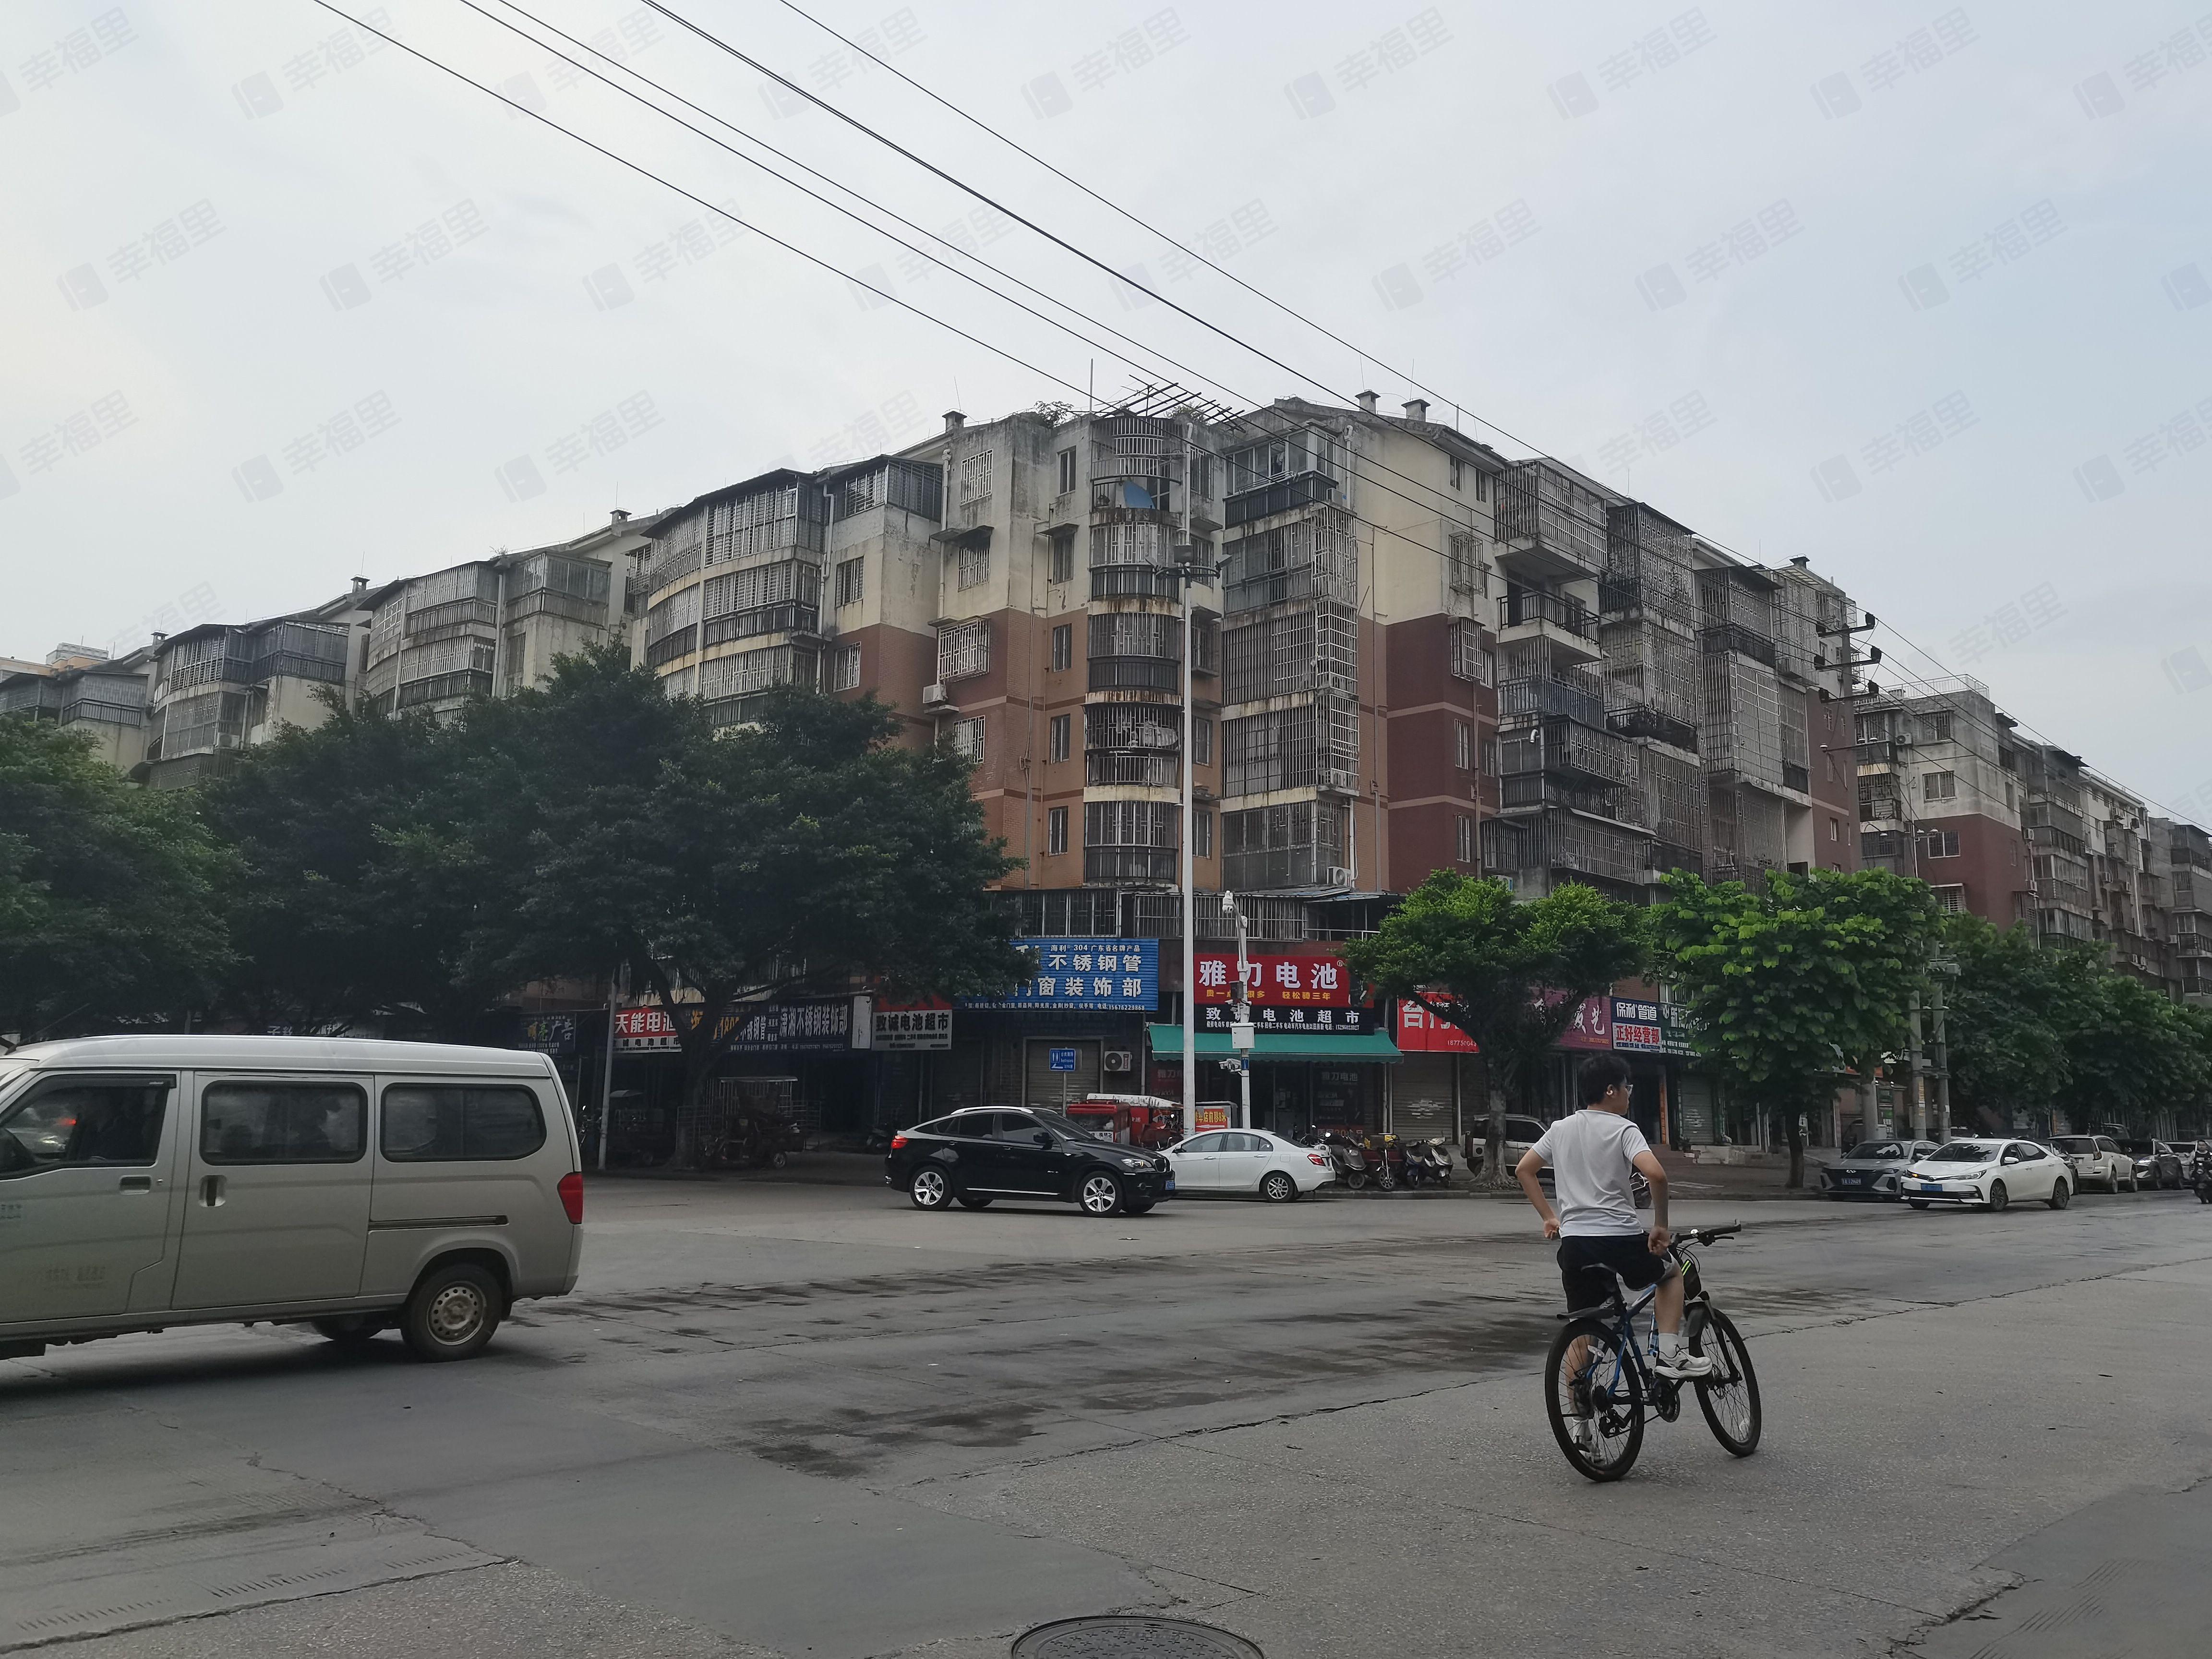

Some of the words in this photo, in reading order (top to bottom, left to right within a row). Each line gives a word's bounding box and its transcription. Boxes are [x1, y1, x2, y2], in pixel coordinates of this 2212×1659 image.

[1048, 955, 1141, 972] 不锈钢管
[1616, 1025, 1659, 1045] 正好经营部
